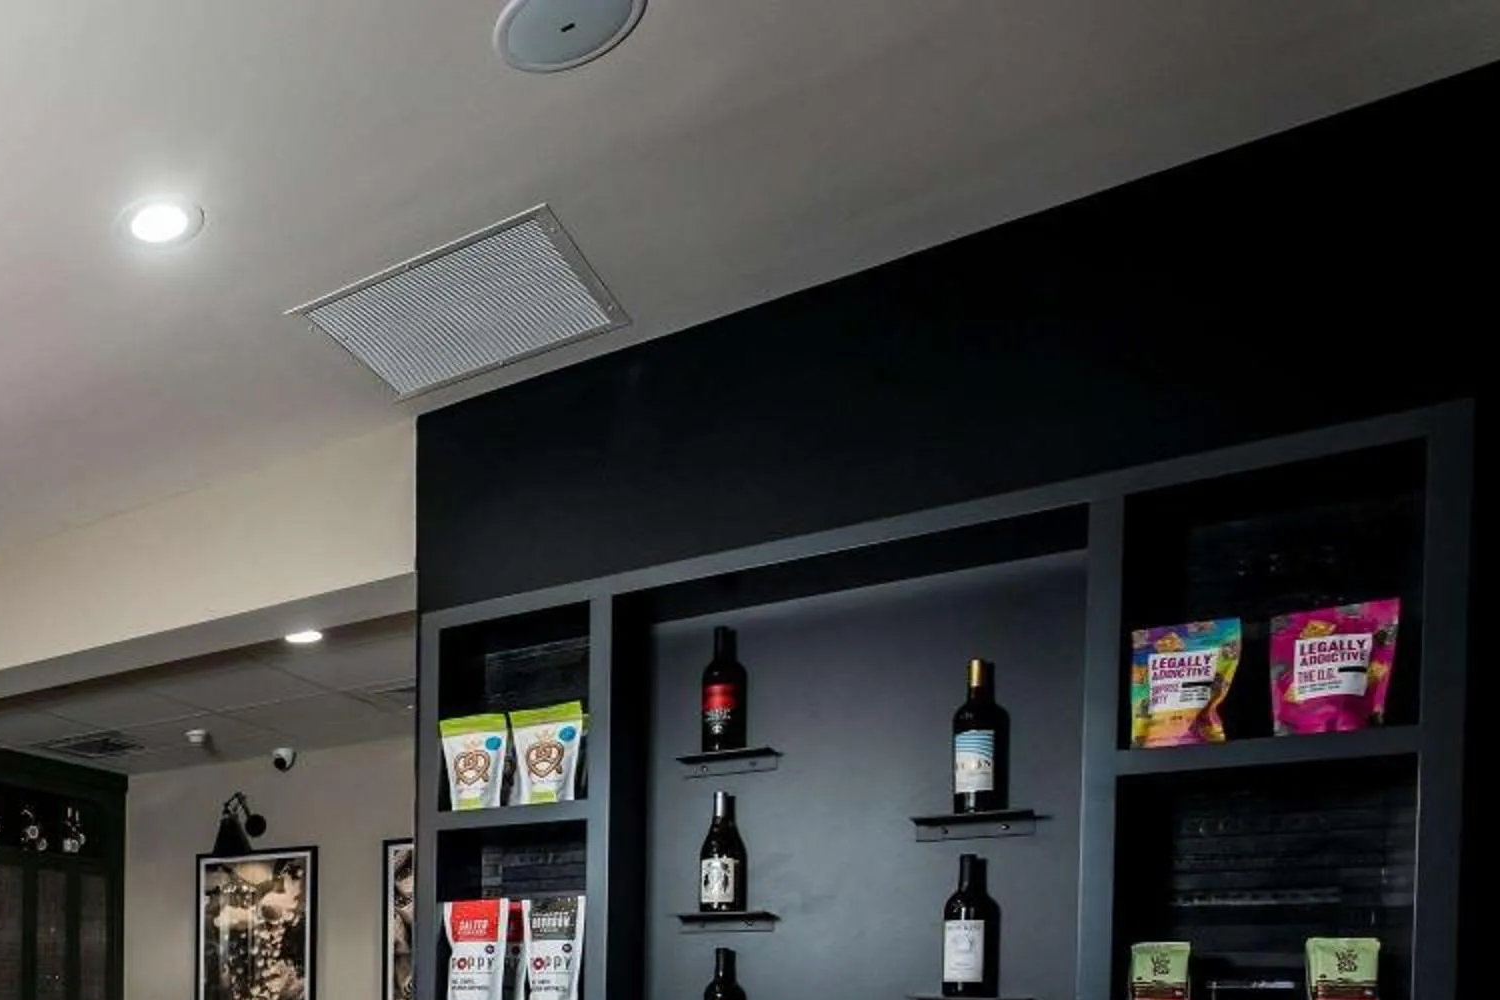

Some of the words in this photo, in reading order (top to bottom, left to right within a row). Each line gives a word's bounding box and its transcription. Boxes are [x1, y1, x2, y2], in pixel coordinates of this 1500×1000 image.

[1300, 639, 1366, 656] LEGALLY
[1152, 653, 1212, 670] LEGALLY
[1300, 650, 1366, 666] ADDICTIVE
[1152, 666, 1212, 681] ADDICTIVE
